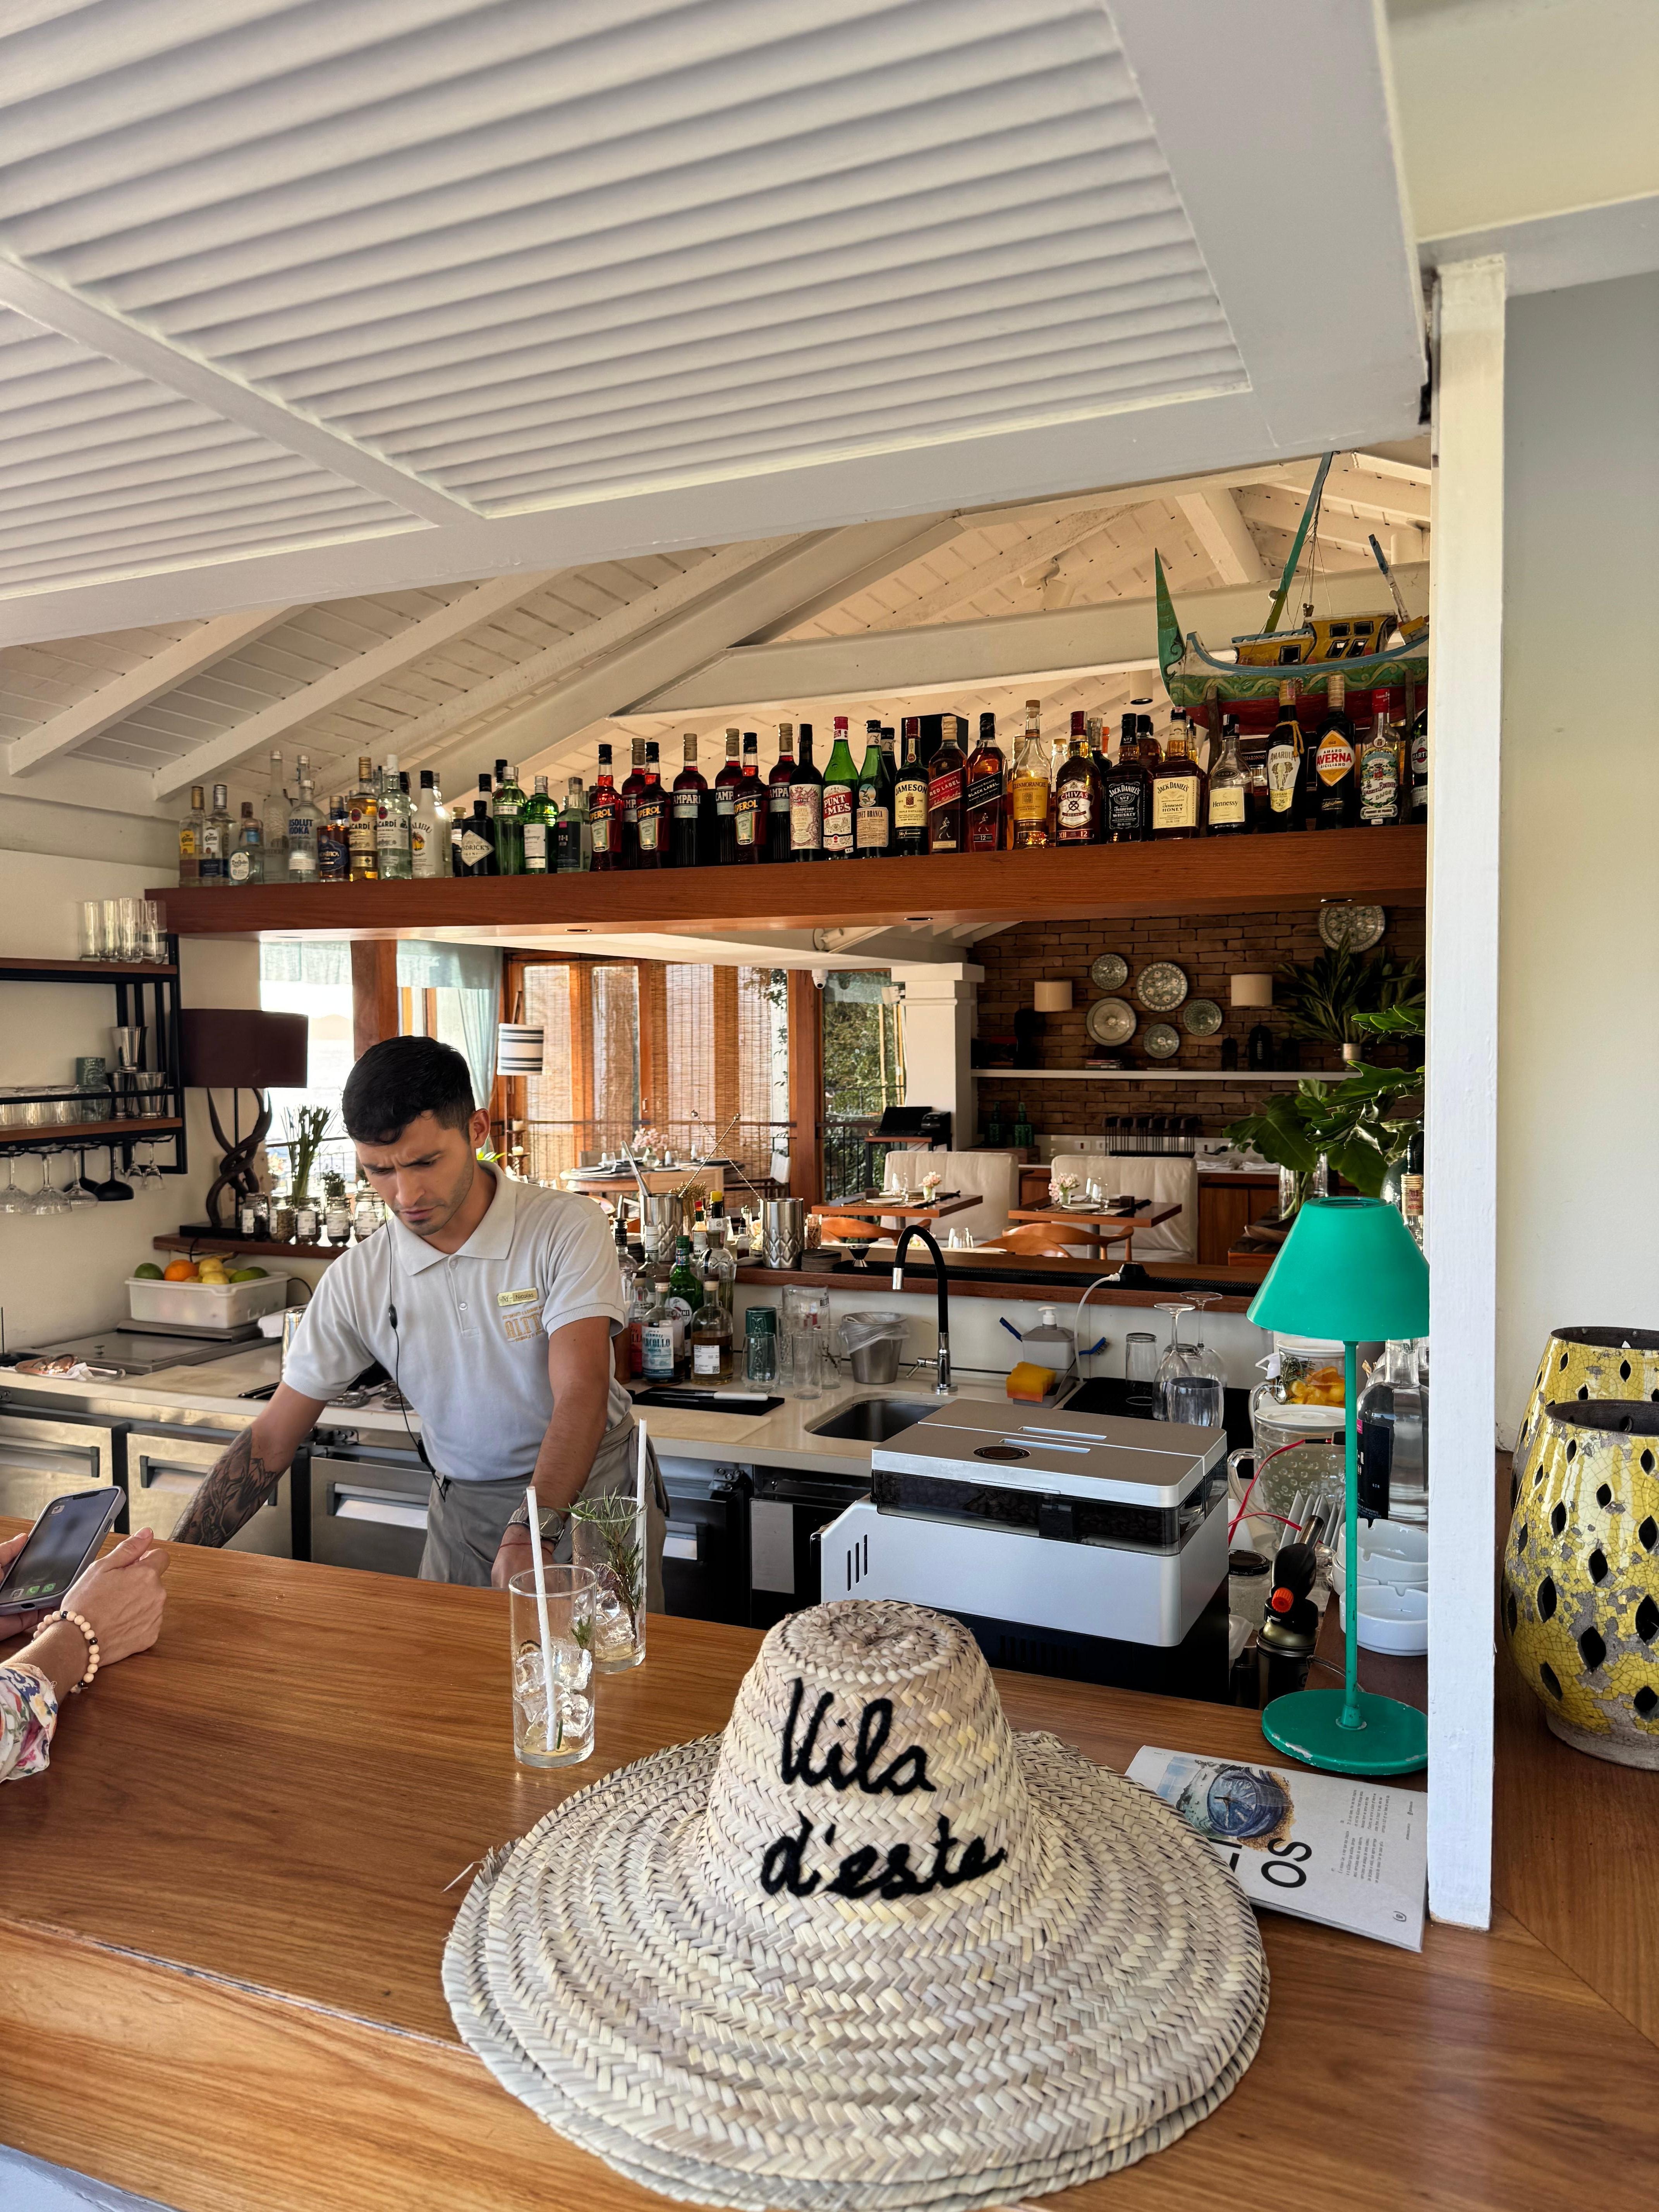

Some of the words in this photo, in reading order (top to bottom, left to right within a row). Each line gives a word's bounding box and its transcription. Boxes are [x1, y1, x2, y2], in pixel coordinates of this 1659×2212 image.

[1317, 752, 1352, 765] AVERNA
[1413, 751, 1427, 760] MARTI
[769, 787, 789, 798] AMPA
[895, 784, 927, 796] JAMESON
[929, 788, 940, 797] RED
[941, 780, 960, 790] LABEL
[968, 788, 983, 798] BLACK
[983, 782, 1000, 791] LABEL
[1109, 787, 1121, 797] JACK
[1121, 785, 1140, 795] DANIEL'S
[1157, 783, 1170, 794] JACK
[1170, 781, 1189, 792] DANIEL'S
[673, 794, 701, 805] AMPARI
[715, 791, 734, 802] CAMP
[824, 794, 846, 808] PUNT
[1061, 791, 1089, 800] CHIVAS
[828, 802, 851, 816] MES
[1212, 800, 1238, 808] Hennessy
[412, 822, 433, 834] ALIBU
[761, 1810, 1007, 1900] d'este
